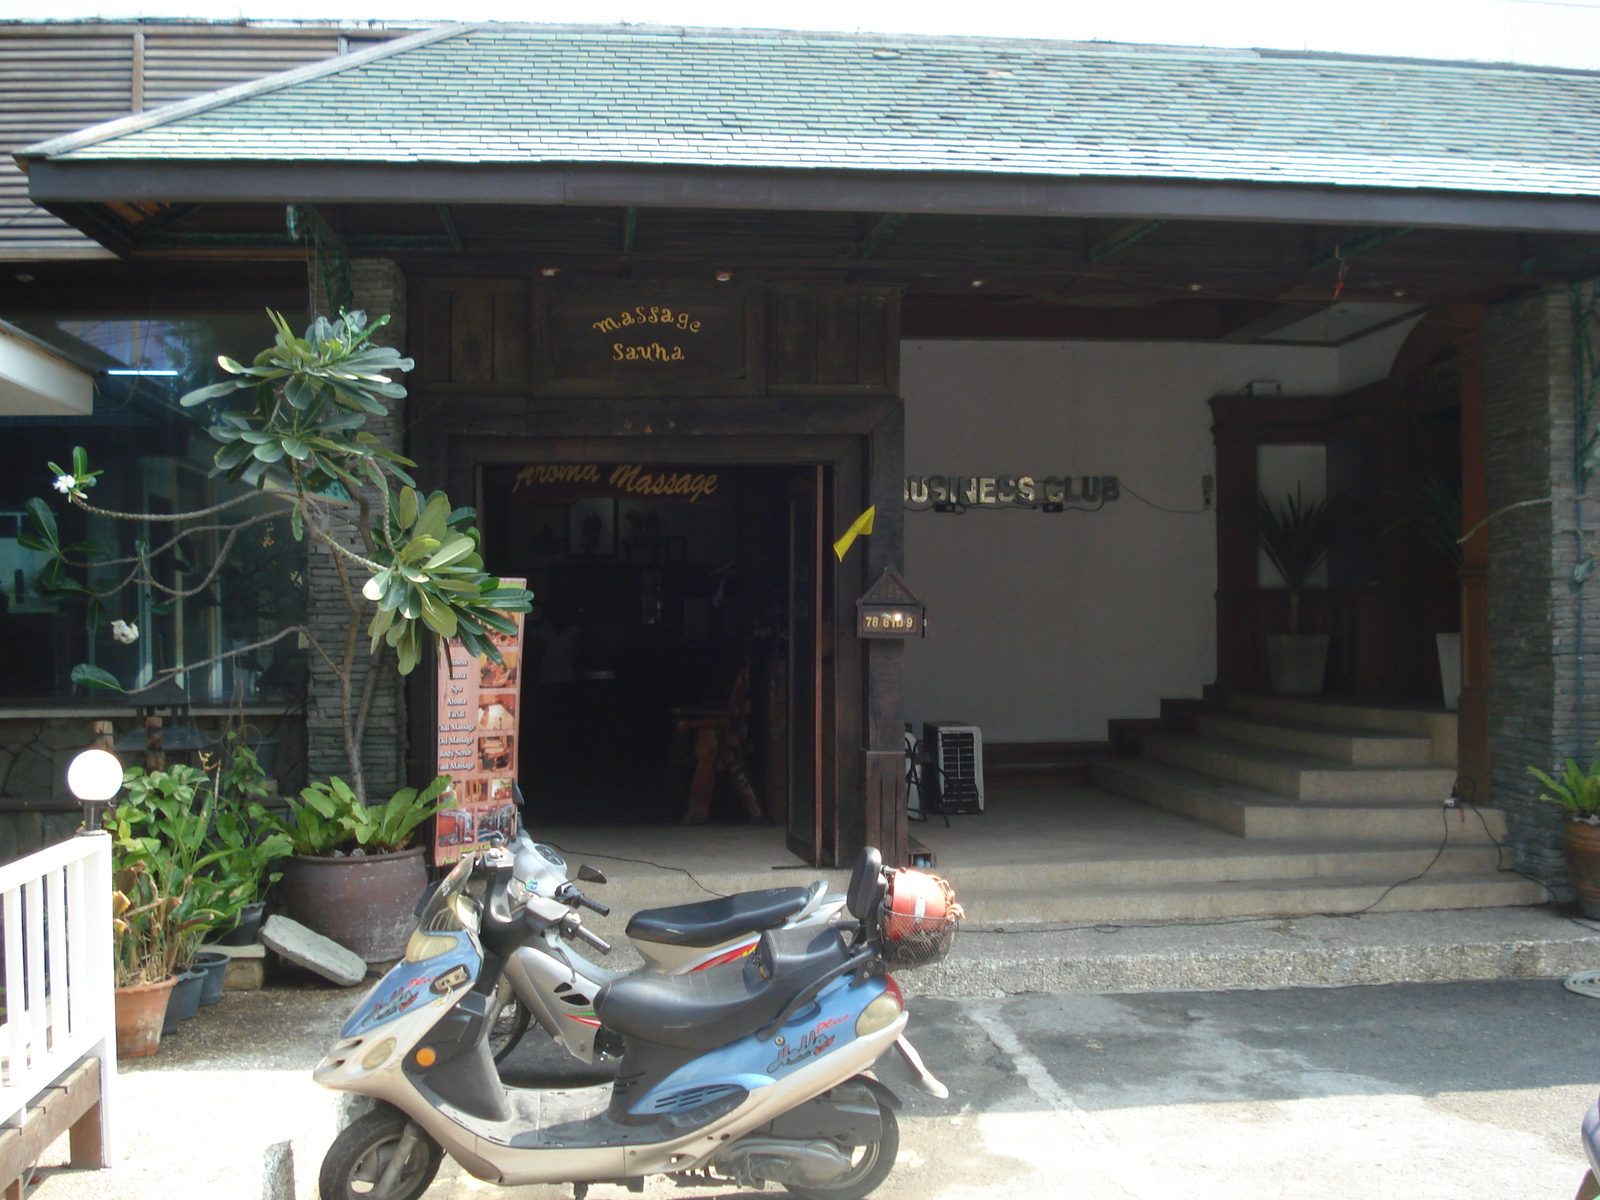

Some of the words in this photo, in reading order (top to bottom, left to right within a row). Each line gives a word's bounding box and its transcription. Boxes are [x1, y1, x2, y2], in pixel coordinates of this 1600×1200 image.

[512, 464, 600, 493] Aroma
[609, 463, 718, 502] Massage
[904, 476, 1035, 504] USINESS
[1044, 475, 1120, 502] CLUB
[451, 685, 463, 694] Spa
[447, 698, 467, 706] Aroma
[451, 723, 475, 732] Massage
[450, 736, 473, 745] Massage
[451, 762, 474, 771] Massage
